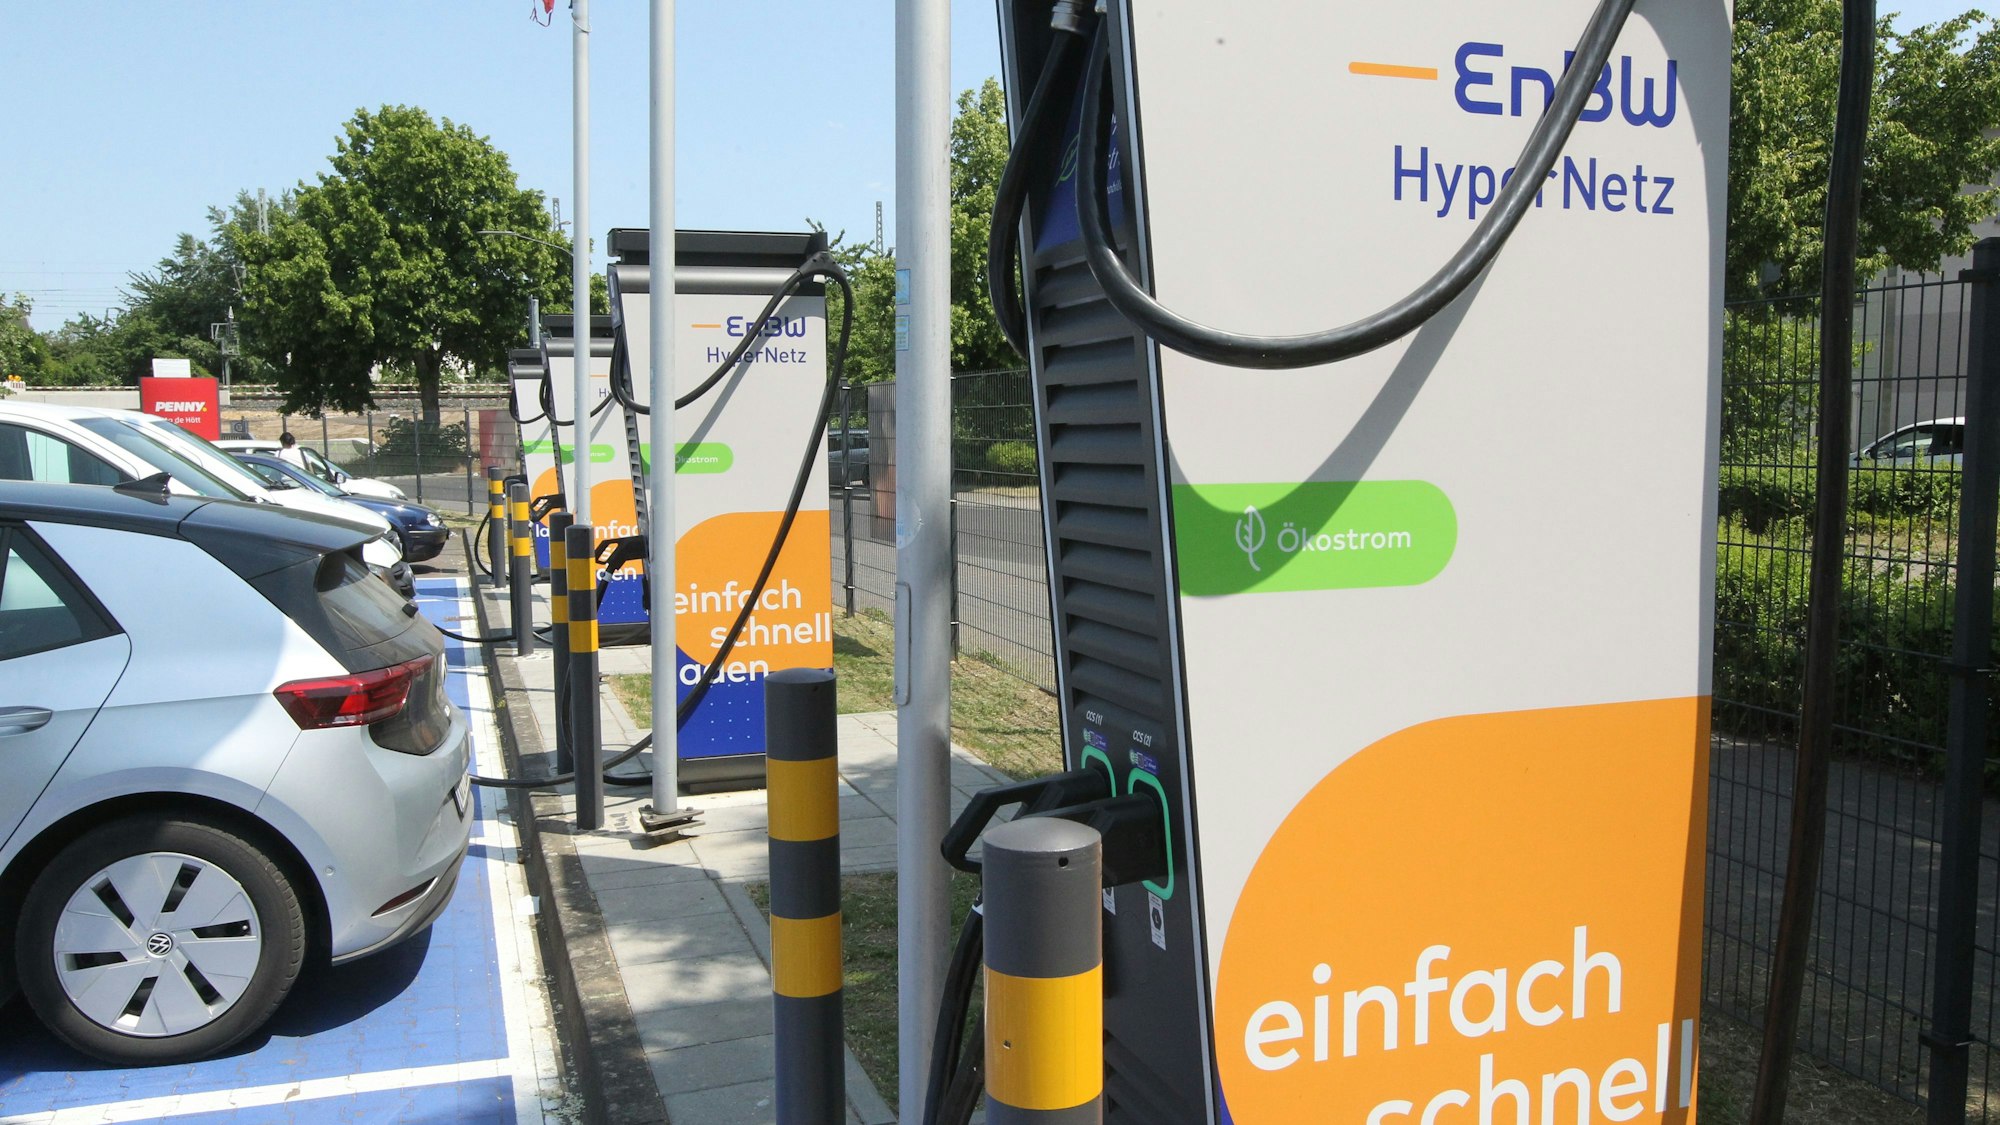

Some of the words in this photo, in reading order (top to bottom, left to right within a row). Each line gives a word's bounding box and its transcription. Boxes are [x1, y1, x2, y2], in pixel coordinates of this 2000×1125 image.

[1394, 144, 1675, 220] HyprNetz
[1277, 522, 1412, 552] Ökostrom
[1243, 925, 1622, 1071] einfach
